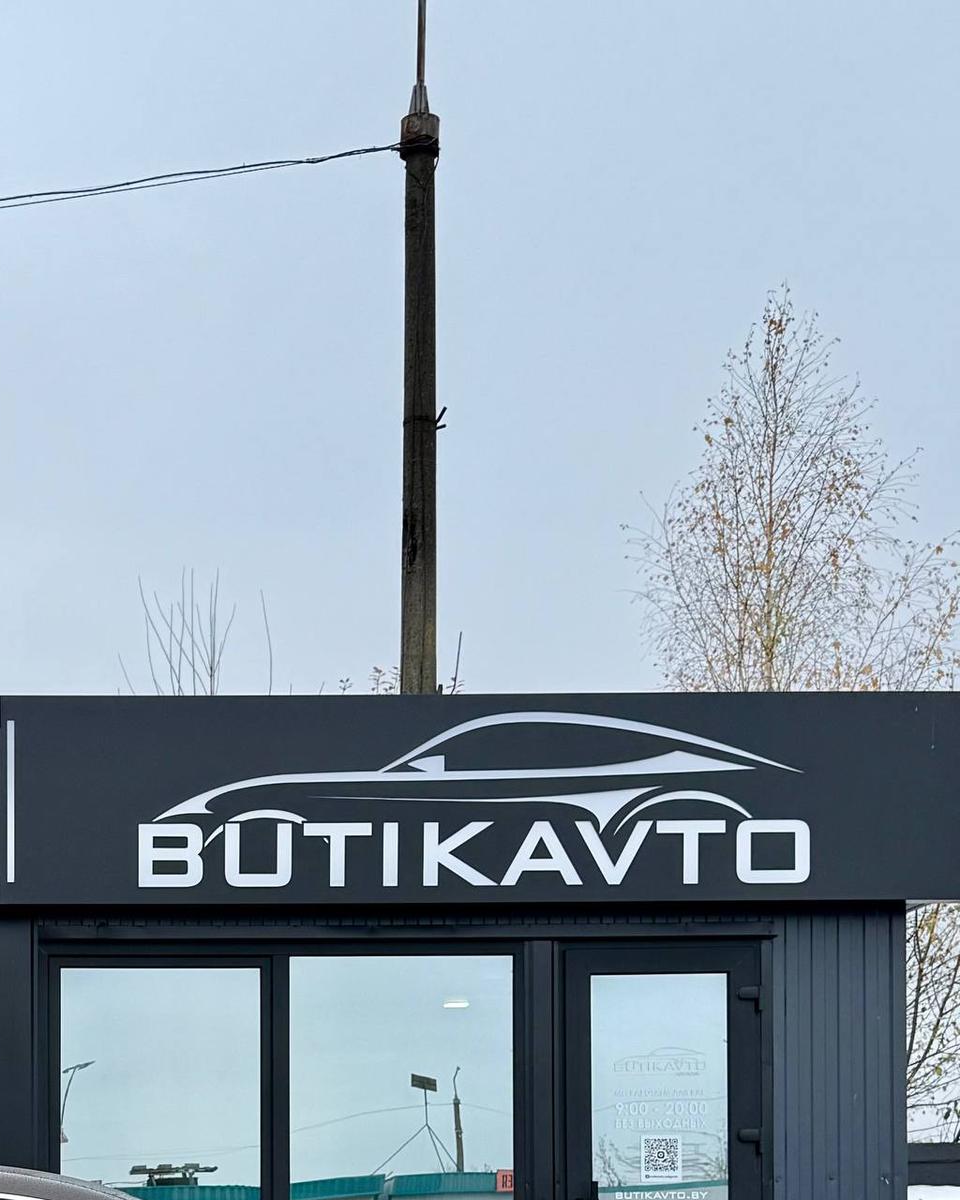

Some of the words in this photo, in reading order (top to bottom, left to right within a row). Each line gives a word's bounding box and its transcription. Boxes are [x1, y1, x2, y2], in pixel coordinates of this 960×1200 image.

[138, 818, 811, 888] BUTIKAVTO
[615, 1102, 648, 1116] 9:00
[664, 1102, 706, 1116] 20:00
[615, 1191, 709, 1200] BUTIKAVTO.BY
